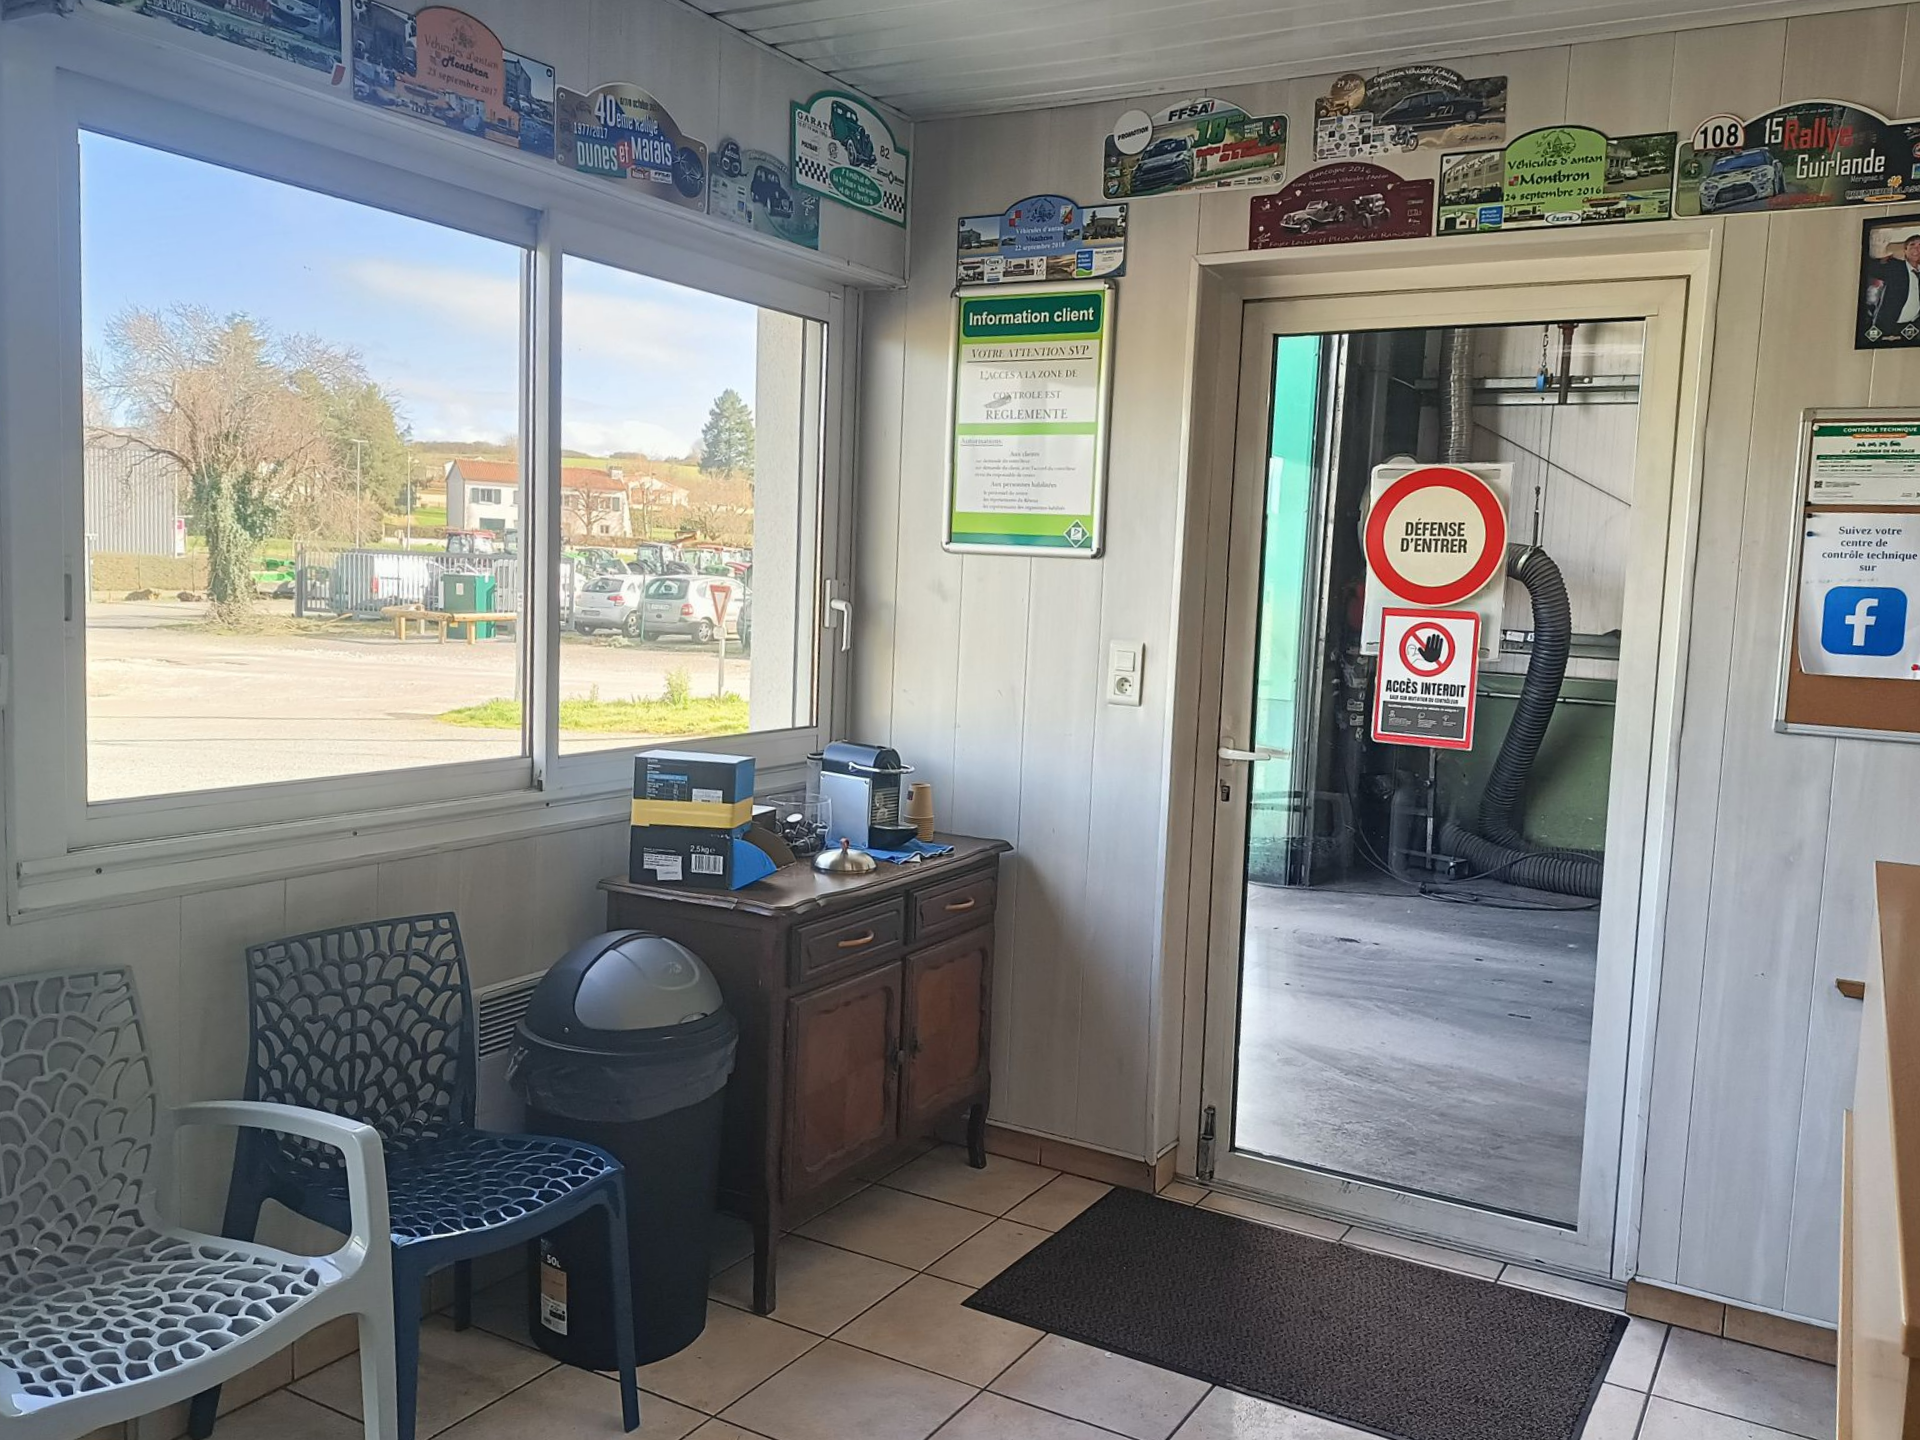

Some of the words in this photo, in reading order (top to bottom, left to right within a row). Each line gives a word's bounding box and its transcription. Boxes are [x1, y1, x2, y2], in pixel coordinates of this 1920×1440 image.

[438, 72, 479, 92] septembre
[1168, 101, 1209, 121] FFSA
[573, 122, 608, 139] 1977/2017
[1118, 126, 1149, 141] PROMOTION
[1700, 124, 1739, 149] 108
[1765, 117, 1783, 145] 15
[1783, 115, 1854, 152] Rallye
[619, 142, 629, 164] et
[631, 136, 672, 166] Marais
[880, 145, 891, 160] 82
[1348, 165, 1371, 174] 2016
[1507, 156, 1558, 170] Véhicules
[1560, 153, 1604, 166] d'antan
[1796, 148, 1885, 179] Guirlande
[1519, 170, 1590, 187] Montbron
[1505, 193, 1516, 202] 24
[1520, 187, 1574, 202] septembre
[1576, 187, 1601, 195] 2016
[969, 309, 1049, 326] Information
[1053, 307, 1094, 322] client
[972, 348, 1005, 358] VOTRE
[1008, 346, 1066, 357] ATTENTION
[1068, 345, 1089, 355] SVP
[1038, 370, 1063, 379] ZONE
[1065, 369, 1078, 378] DE
[1044, 390, 1062, 399] EST
[1405, 518, 1466, 537] DÉFENSE
[1838, 526, 1872, 535] Suivez
[1875, 527, 1902, 535] votre
[1400, 538, 1467, 553] D'ENTRER
[1875, 539, 1888, 547] de
[1822, 550, 1864, 559] contrôle
[1866, 551, 1918, 564] technique
[1385, 678, 1418, 694] ACCÈS
[1421, 682, 1466, 697] INTERDIT
